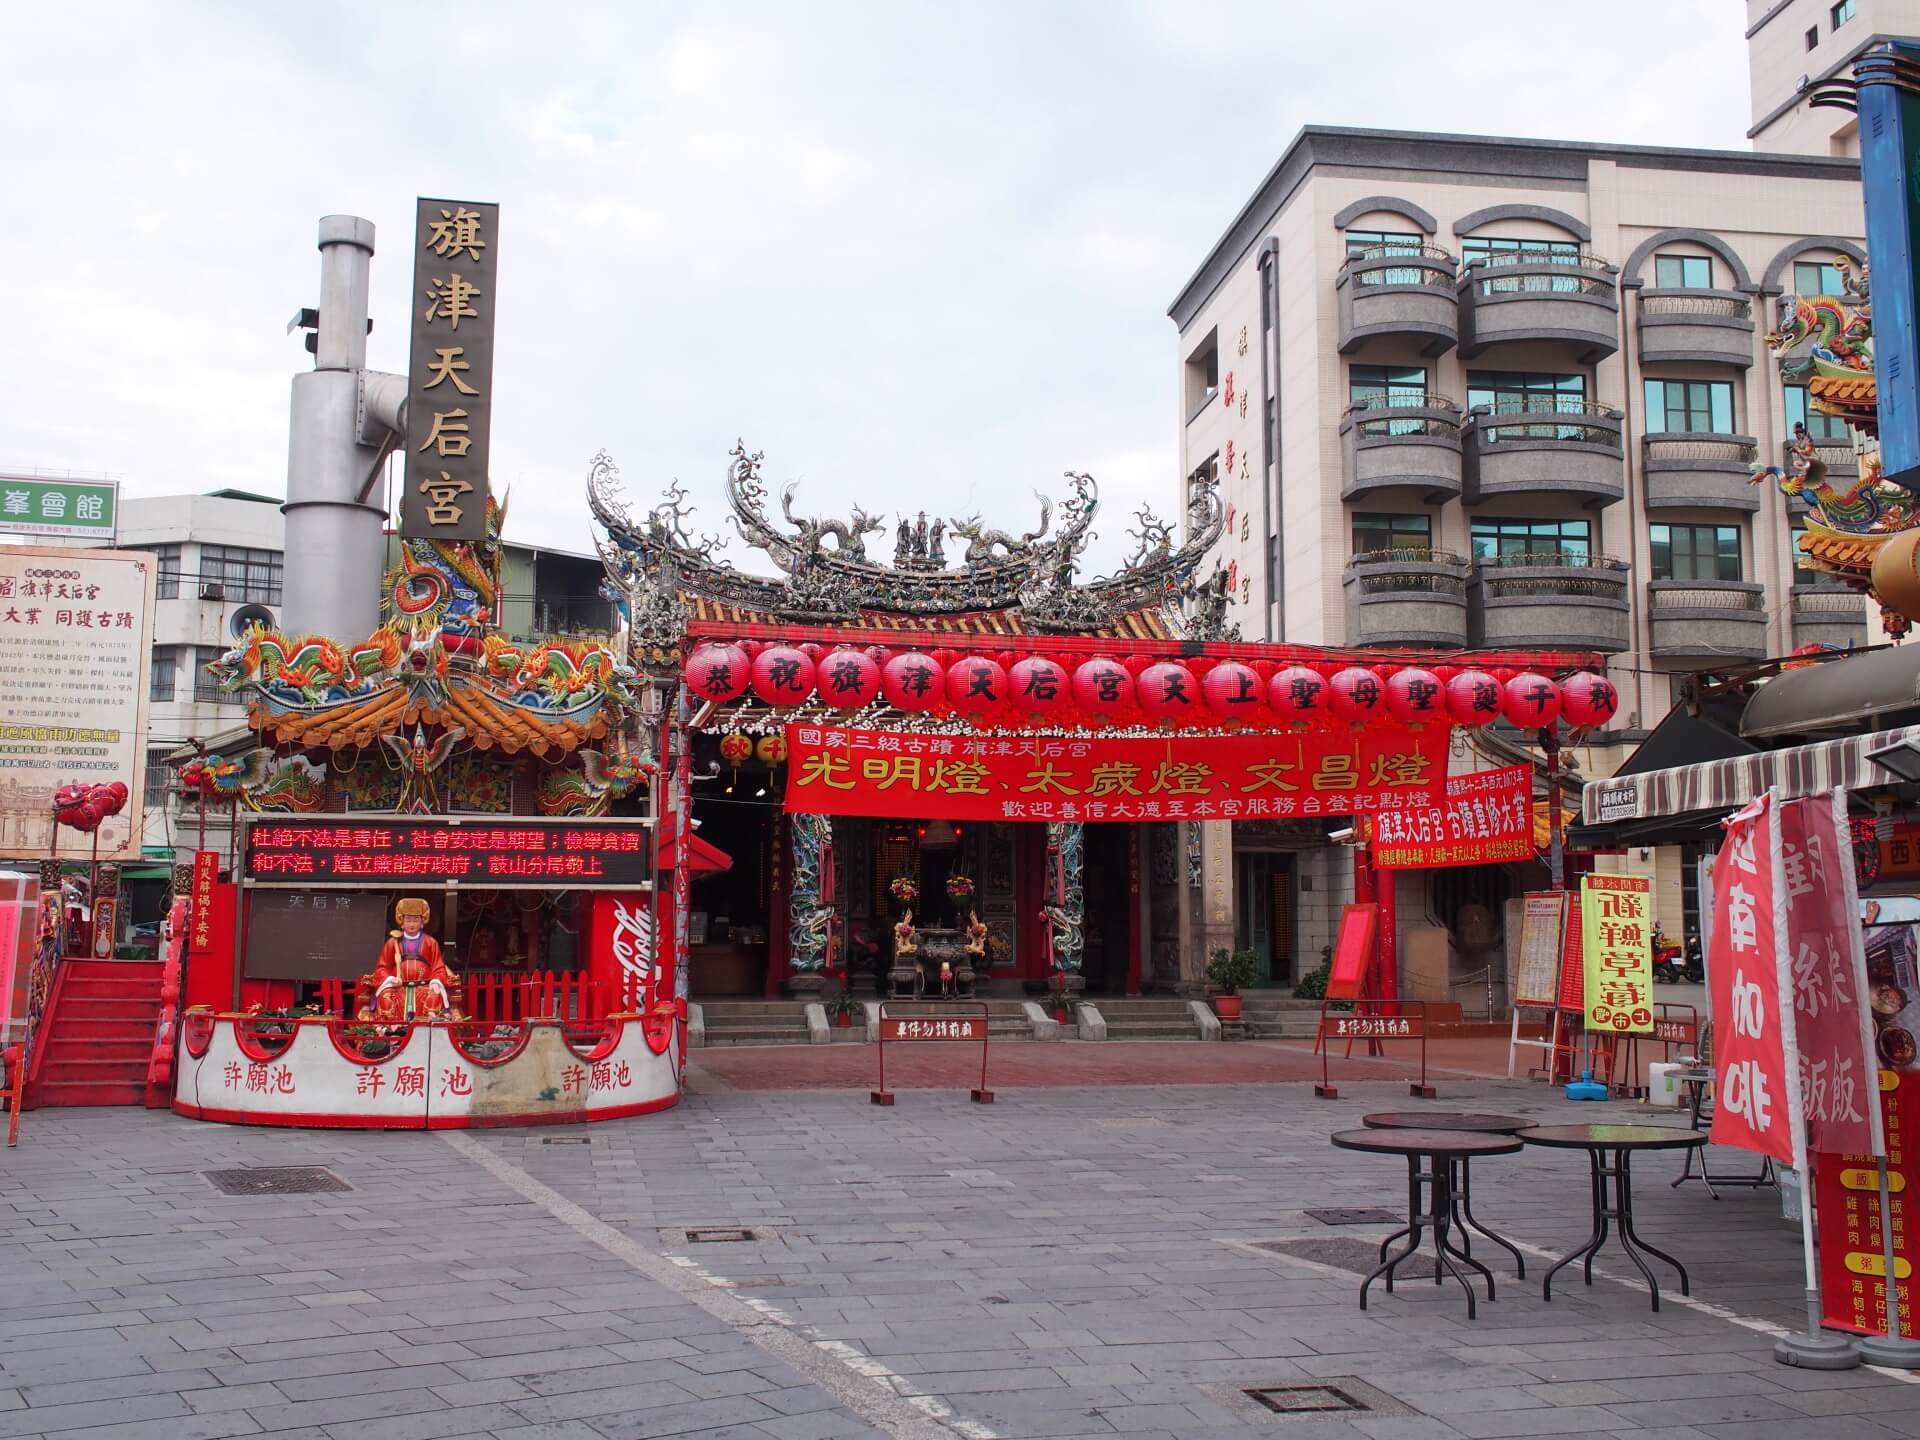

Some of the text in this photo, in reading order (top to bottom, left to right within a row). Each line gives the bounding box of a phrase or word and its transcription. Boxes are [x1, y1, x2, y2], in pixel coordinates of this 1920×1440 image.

[418, 206, 487, 527] 旗津天后宮
[4, 489, 104, 520] 峯會館
[20, 579, 100, 601] 旗津天后宮
[55, 608, 136, 630] 同護古蹟
[799, 728, 1093, 758] 國家三級古蹟 旗津天后宮
[1001, 792, 1432, 818] 歡迎善信大德至本宮服務台登記點燈
[1378, 790, 1526, 845] 旗津天后宮 古蹟重修大業
[223, 1061, 296, 1095] 許願池
[357, 1066, 473, 1098] 許願池
[562, 1059, 633, 1094] 許願池
